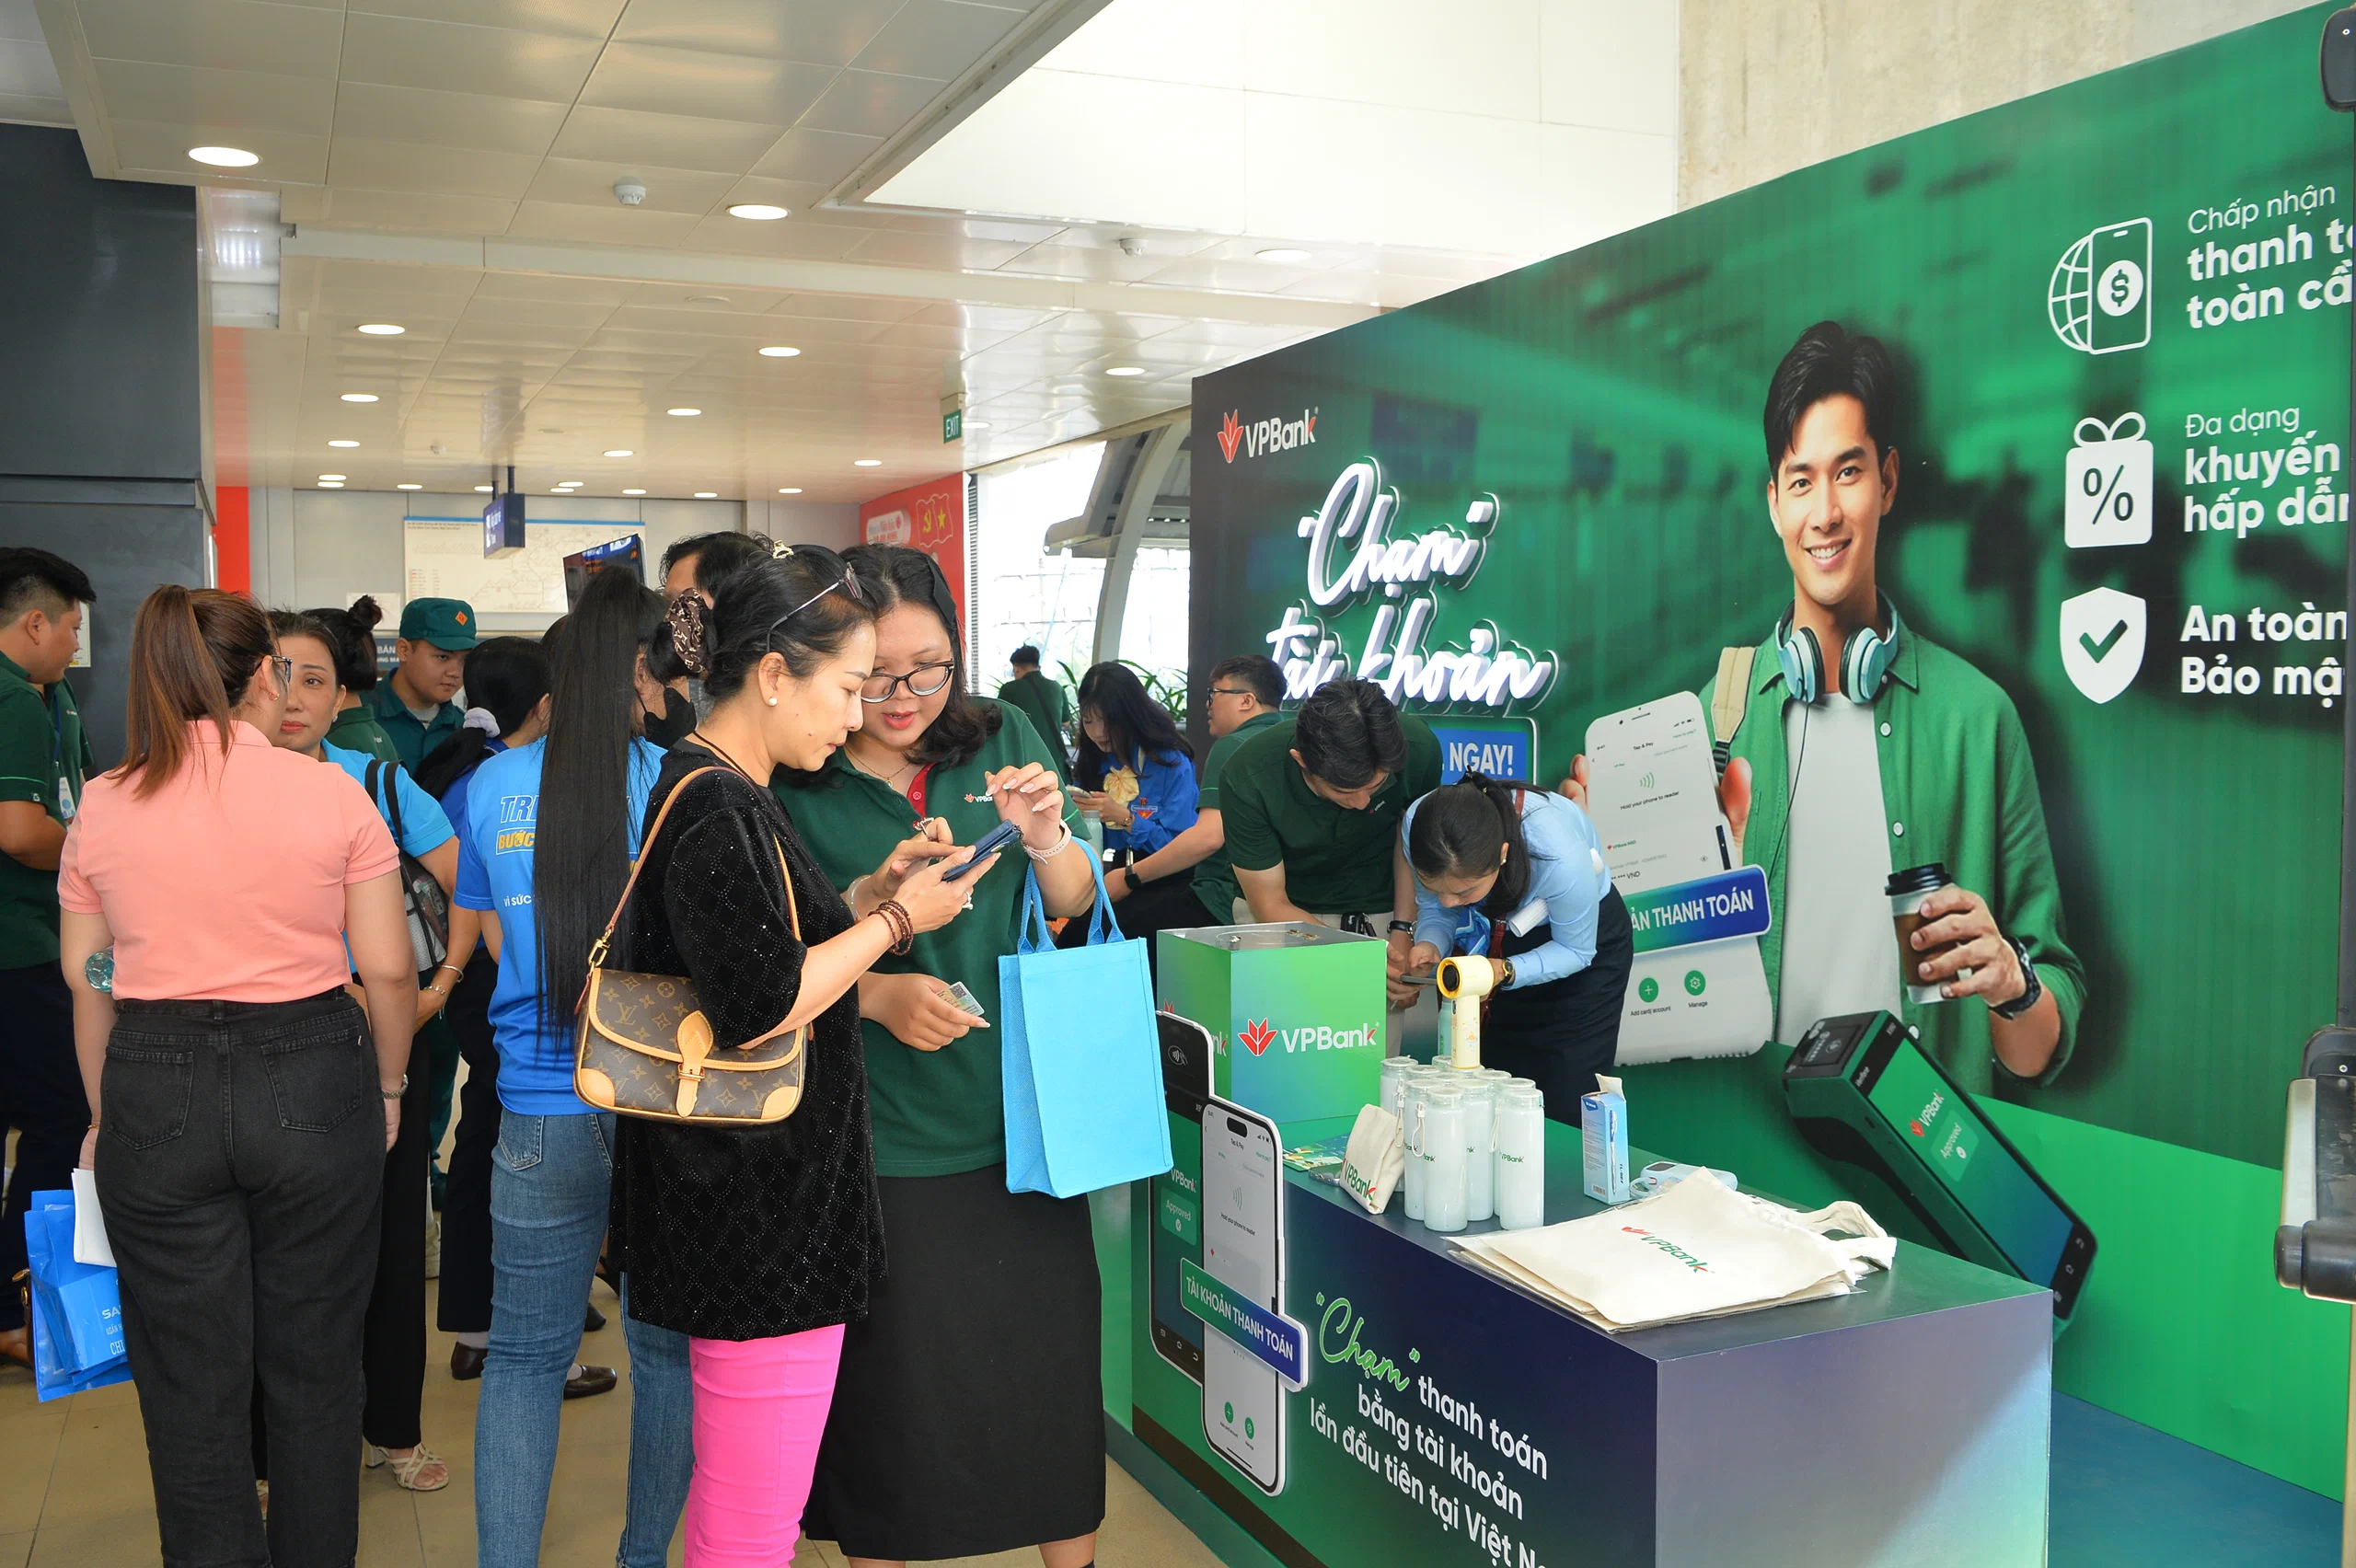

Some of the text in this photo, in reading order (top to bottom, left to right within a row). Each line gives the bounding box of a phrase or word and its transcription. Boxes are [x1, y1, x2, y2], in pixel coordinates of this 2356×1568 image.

[2188, 184, 2335, 234] Chấp nhận
[2187, 223, 2313, 282] thanh
[2187, 282, 2284, 329] toàn
[945, 415, 959, 438] EXIT
[1245, 409, 1316, 458] VPBank
[2185, 407, 2300, 437] Đa dạng
[2185, 430, 2340, 489] khuyến
[2184, 487, 2265, 538] hấp
[2179, 602, 2347, 642] An toàn
[1355, 597, 1552, 707] khoản
[2181, 653, 2260, 695] Bảo
[1449, 742, 1514, 777] NGAY!
[511, 894, 533, 906] SỨC
[1652, 899, 1705, 928] THANH
[1706, 886, 1754, 917] TOÁN
[1280, 1022, 1377, 1054] VPBank
[1918, 1091, 1945, 1127] VPBank
[1939, 1122, 1963, 1159] Approved
[1171, 1169, 1196, 1193] VPBank
[1345, 1160, 1377, 1201] VPBank
[1166, 1199, 1192, 1222] Approved
[1640, 1236, 1709, 1274] VPBank
[1186, 1276, 1293, 1362] TÀI KHOẢN THANH TOÁN
[1417, 1375, 1484, 1441] thanh
[1489, 1418, 1547, 1481] toán
[1358, 1383, 1523, 1521] bằng tài khoản
[1311, 1397, 1547, 1568] lần đầu tiên tại Việt N
